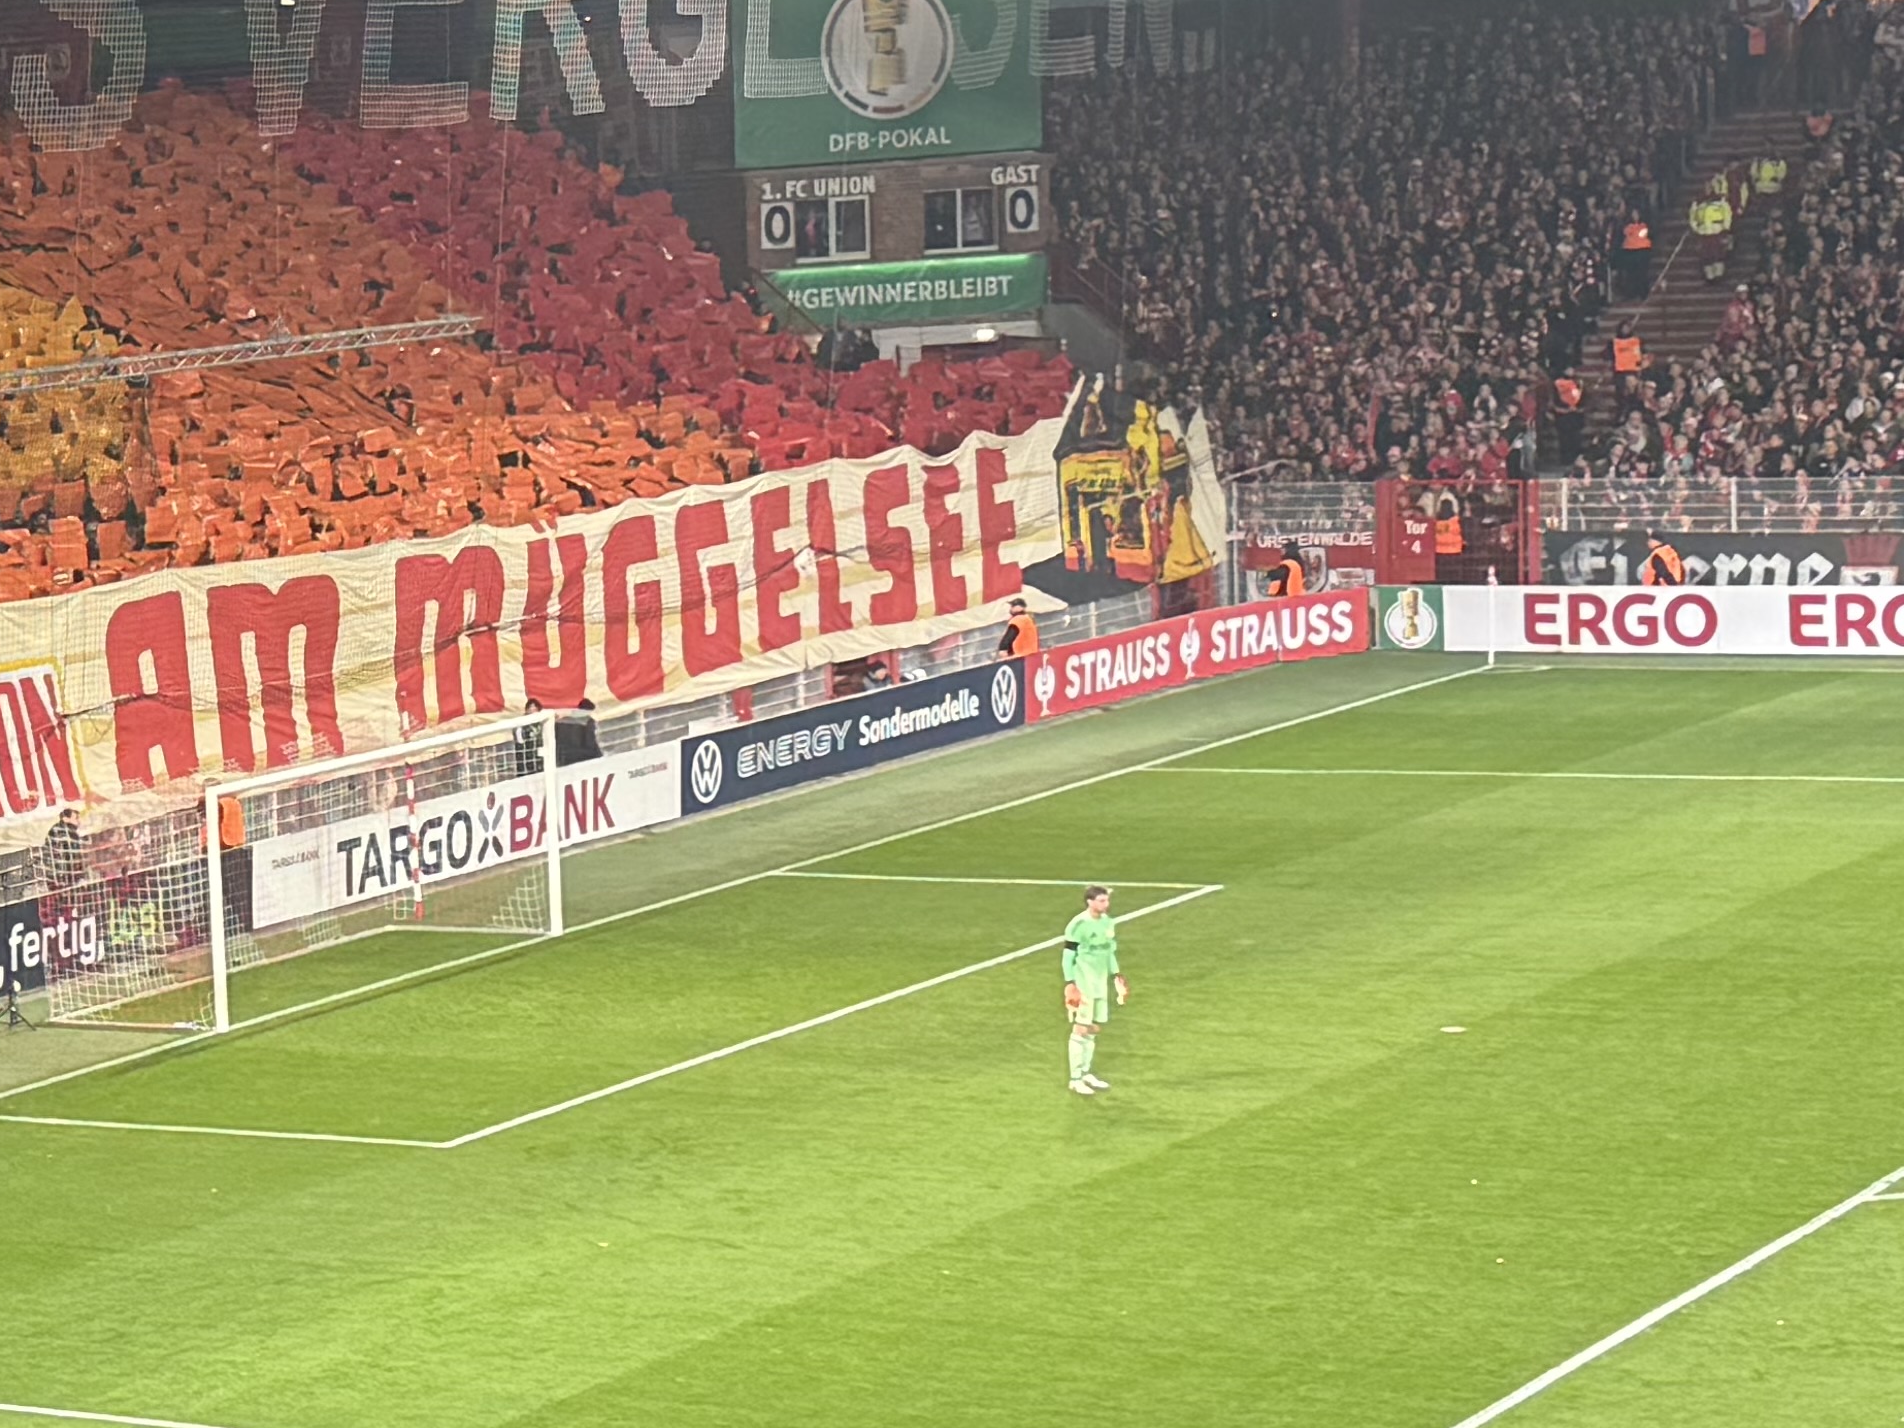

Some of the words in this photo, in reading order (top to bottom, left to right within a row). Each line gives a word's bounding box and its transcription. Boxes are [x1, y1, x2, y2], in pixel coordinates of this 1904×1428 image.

[829, 127, 951, 153] DFB-POKAL
[761, 182, 781, 200] 1.
[786, 179, 808, 198] FC
[814, 174, 876, 196] UNION
[991, 164, 1040, 186] GAST
[764, 204, 792, 246] 0
[1008, 188, 1035, 230] 0
[788, 275, 1013, 310] #GEWINNERBLEIBT
[1405, 520, 1428, 535] Tor
[1411, 541, 1421, 554] 4
[106, 572, 344, 794] AM
[395, 445, 1022, 740] MÜGGELSEE
[1523, 592, 1718, 647] ERGO
[1064, 632, 1171, 700] STRAUSS
[1210, 600, 1353, 664] STRAUSS
[737, 720, 852, 779] ENERGY
[859, 688, 980, 747] Sondermodelle
